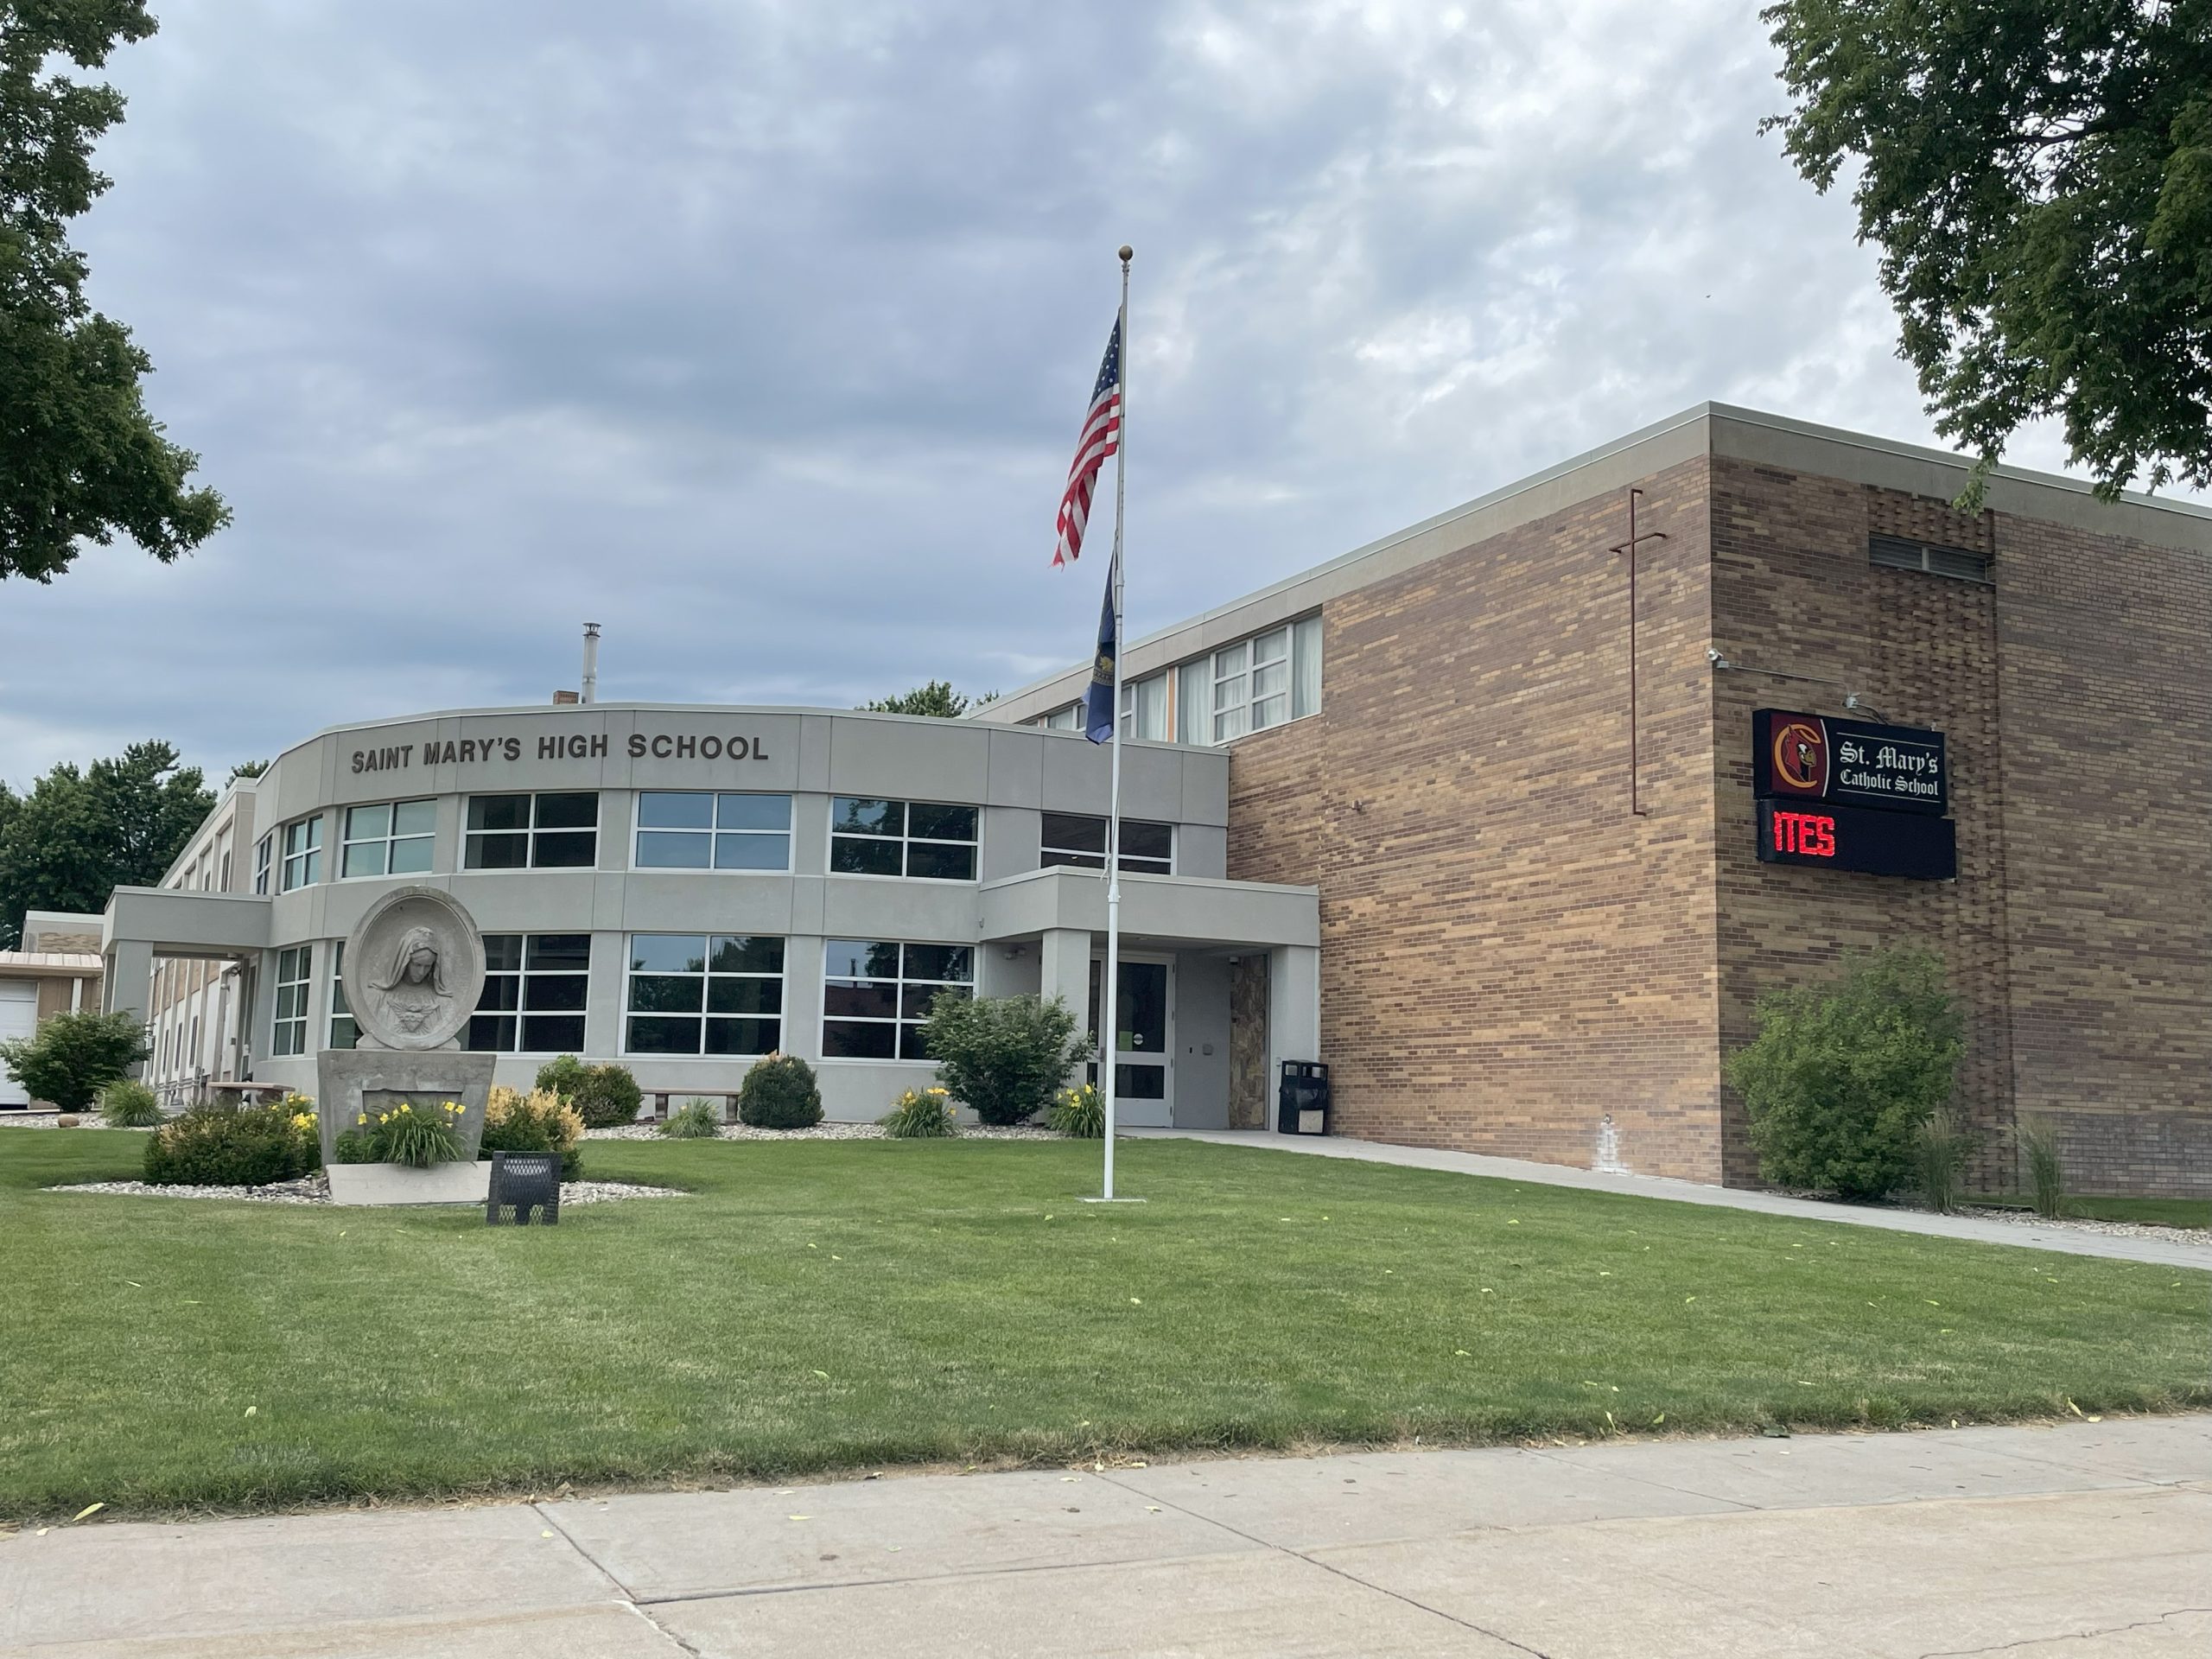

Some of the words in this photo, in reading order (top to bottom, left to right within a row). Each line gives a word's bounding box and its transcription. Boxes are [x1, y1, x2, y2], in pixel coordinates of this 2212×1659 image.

[351, 745, 413, 774] SAINT
[423, 736, 521, 765] MARY'S
[537, 734, 608, 760] HIGH
[626, 734, 769, 760] SCHOOL
[1840, 741, 1871, 766] St.
[1875, 746, 1939, 776] Mary's
[1840, 768, 1892, 790] Catholic
[1894, 775, 1940, 796] School
